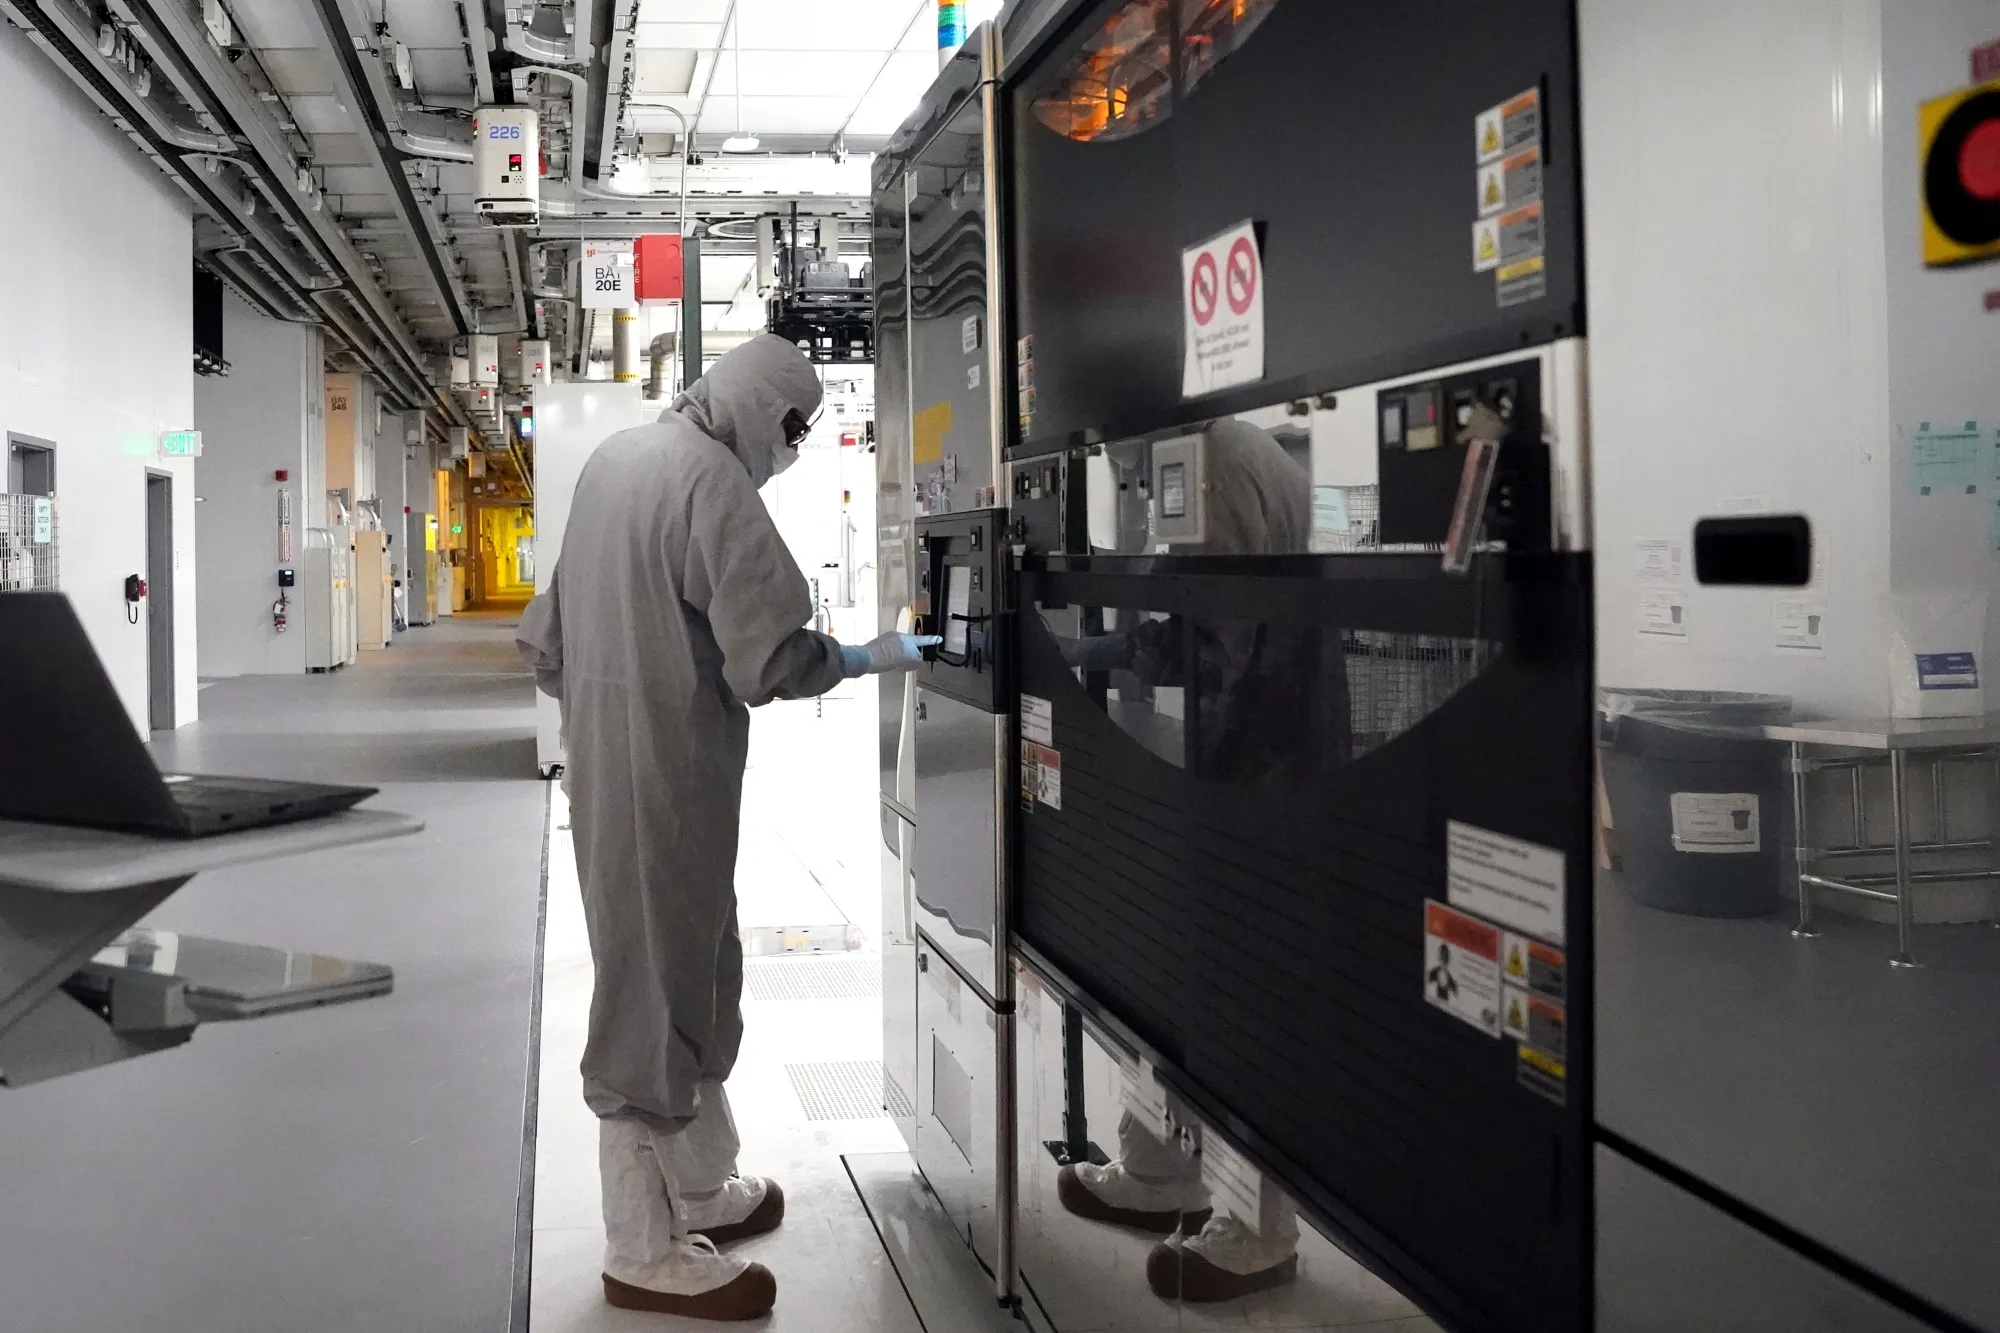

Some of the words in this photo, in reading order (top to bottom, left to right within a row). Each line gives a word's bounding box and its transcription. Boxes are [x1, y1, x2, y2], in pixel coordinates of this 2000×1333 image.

[489, 125, 520, 139] 226
[595, 280, 622, 291] 20E
[331, 396, 347, 404] BAY
